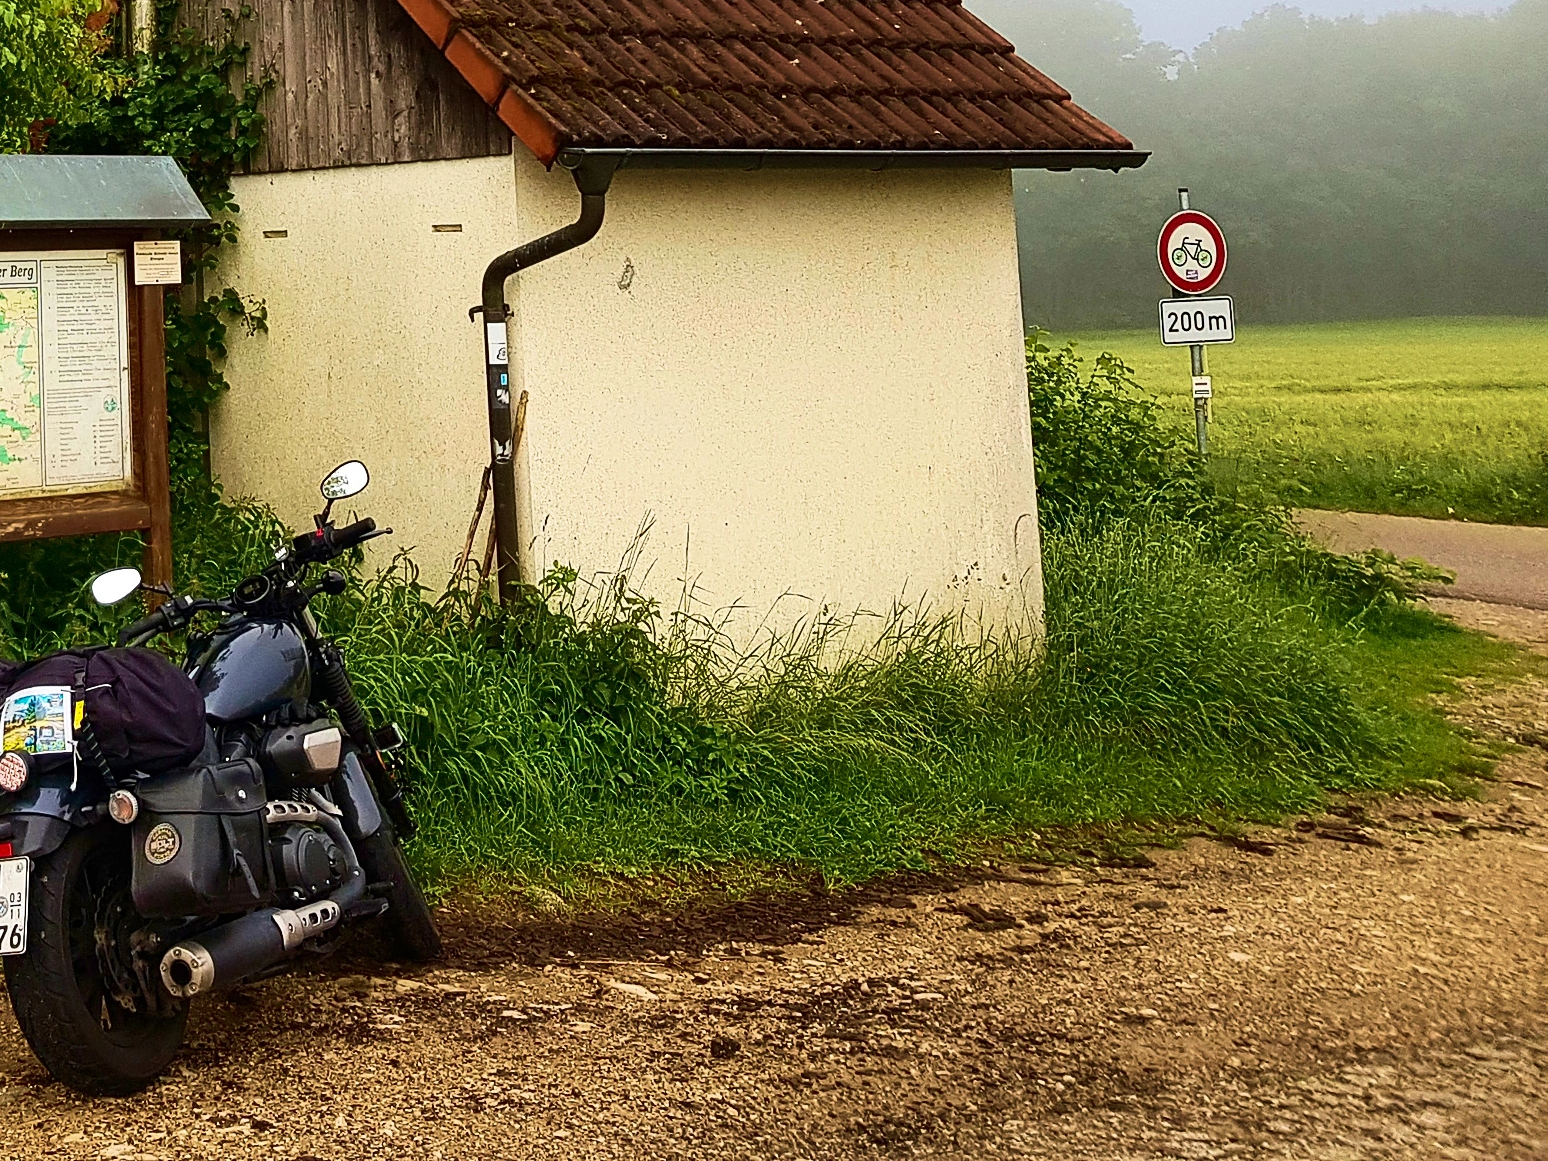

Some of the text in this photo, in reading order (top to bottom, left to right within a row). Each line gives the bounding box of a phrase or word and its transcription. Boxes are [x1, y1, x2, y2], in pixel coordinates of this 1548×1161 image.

[10, 265, 34, 281] Berg
[1167, 311, 1227, 332] 200 m
[10, 892, 22, 902] 03
[10, 908, 20, 919] 11
